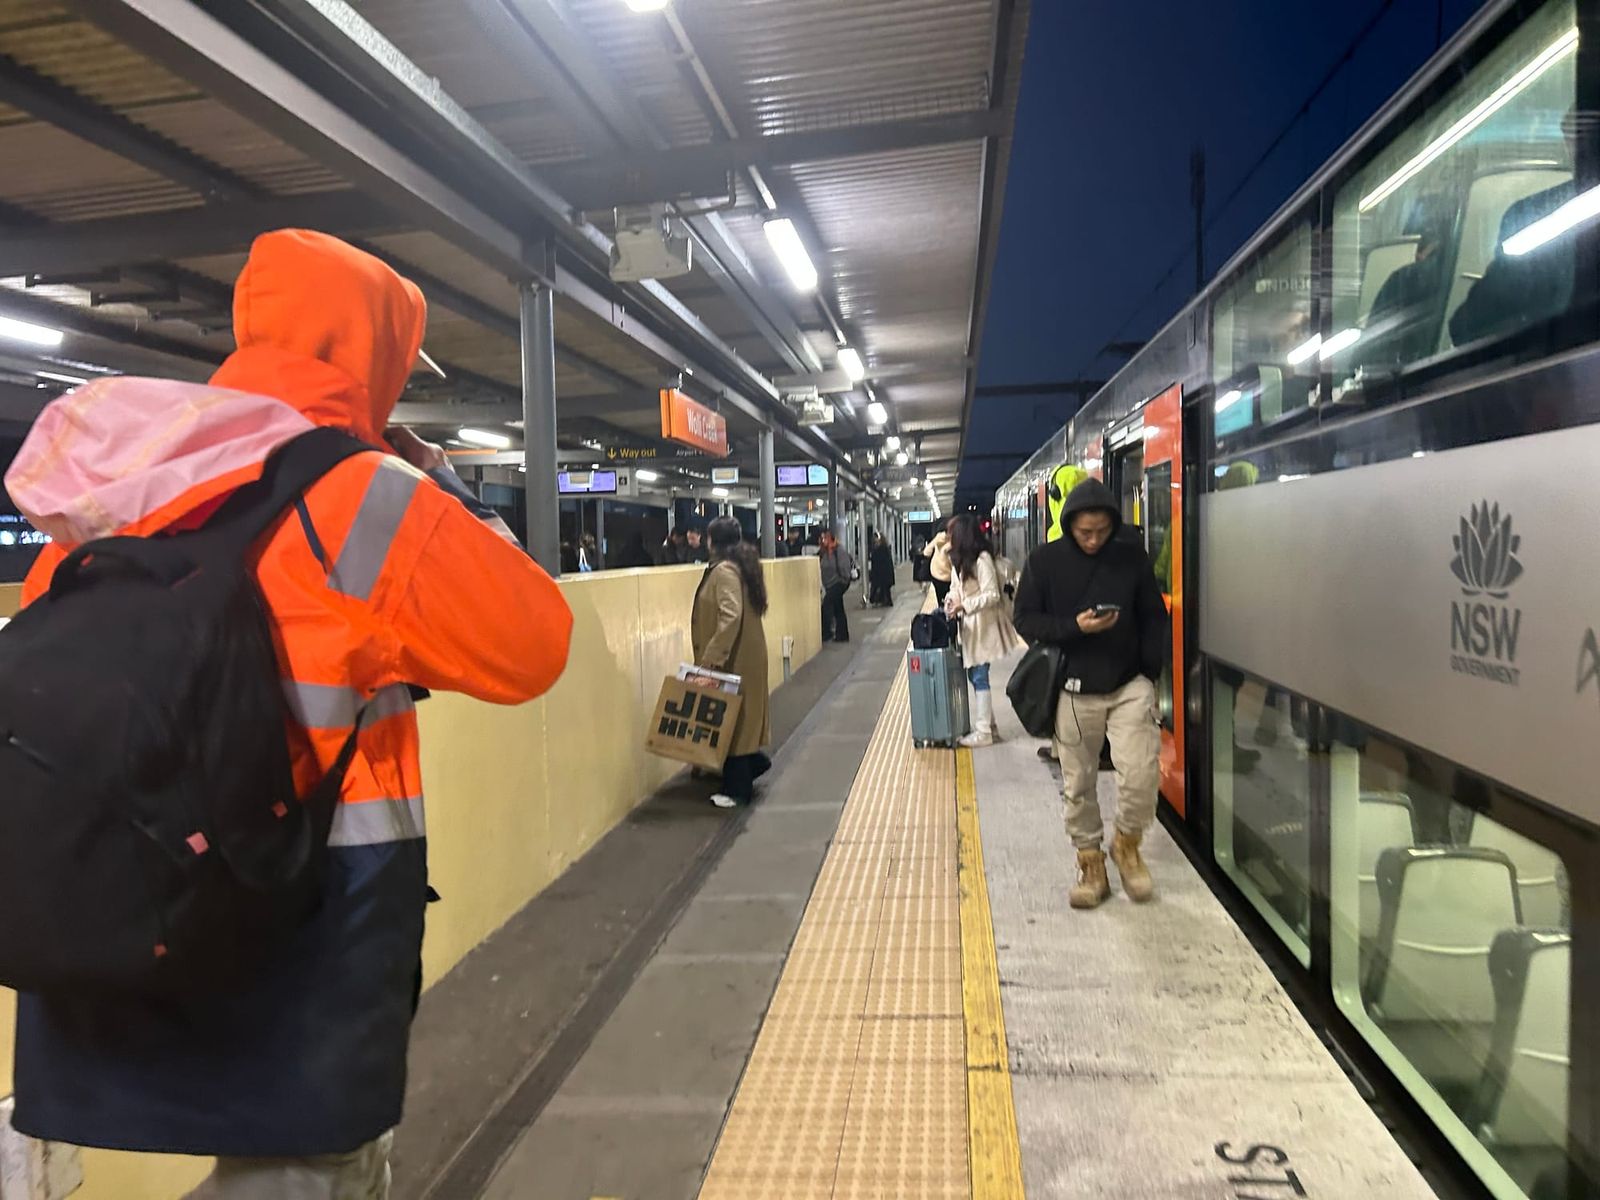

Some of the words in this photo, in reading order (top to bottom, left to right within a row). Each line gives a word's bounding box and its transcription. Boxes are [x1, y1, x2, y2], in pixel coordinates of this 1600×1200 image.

[620, 448, 639, 458] Way
[640, 448, 656, 457] out
[1451, 600, 1521, 663] NSW
[665, 691, 727, 727] JB
[1214, 1141, 1308, 1200] ST
